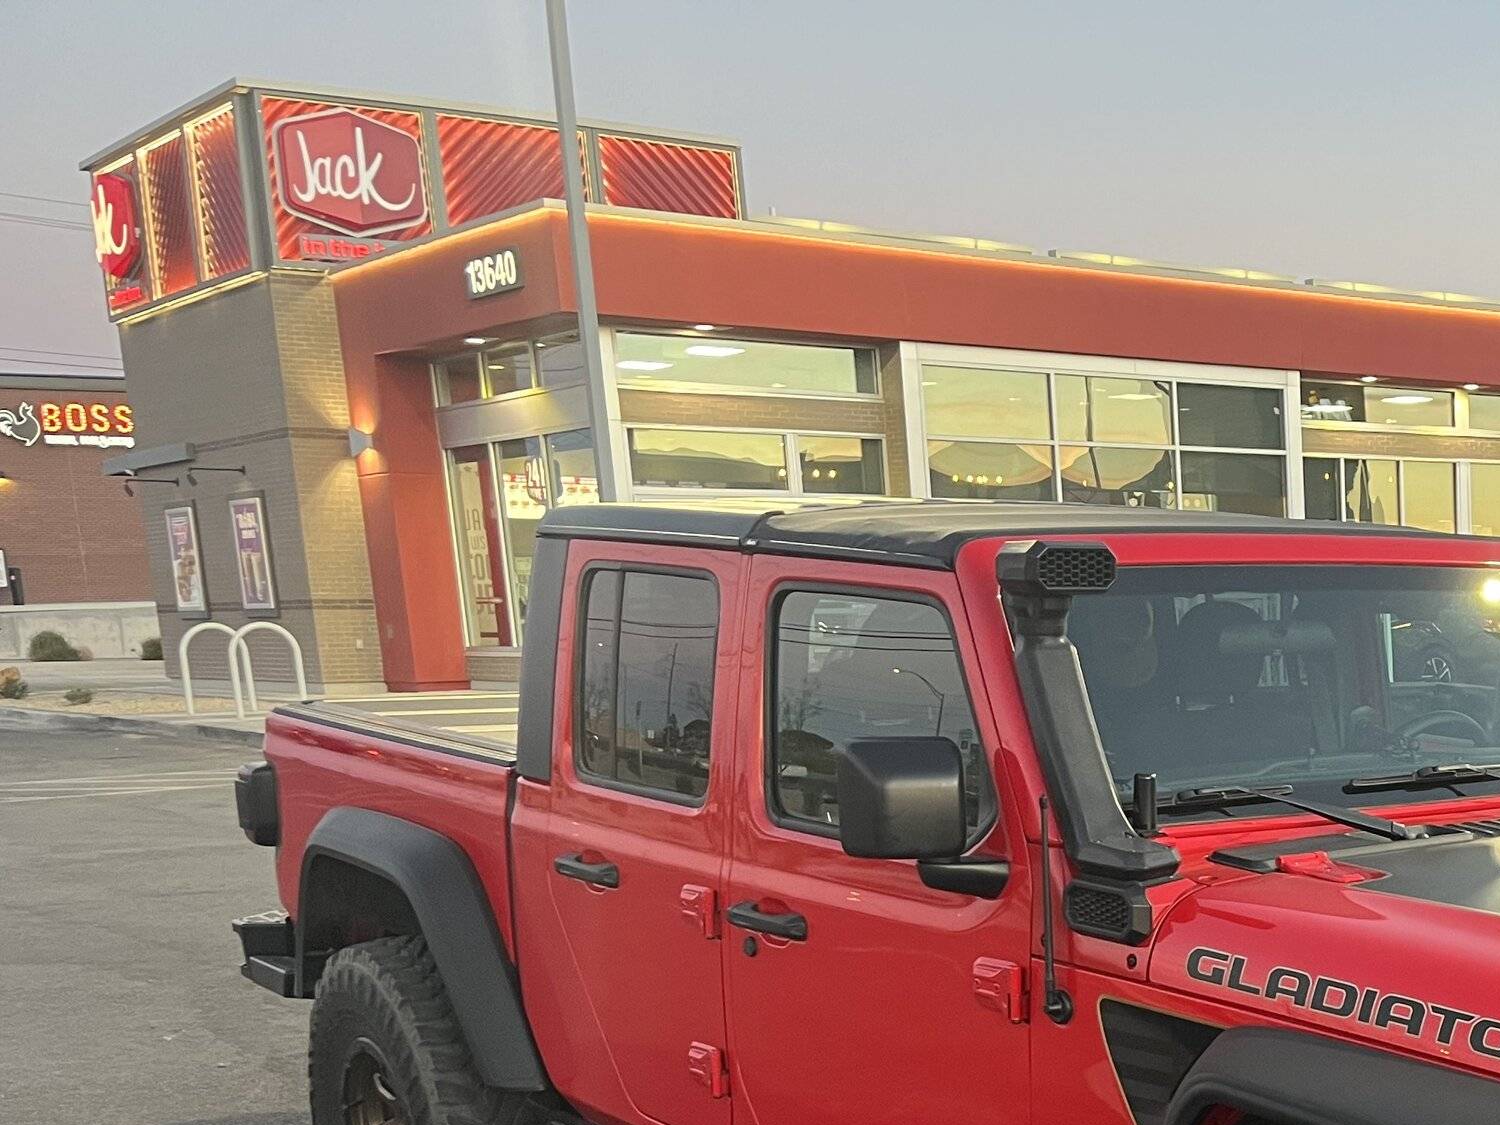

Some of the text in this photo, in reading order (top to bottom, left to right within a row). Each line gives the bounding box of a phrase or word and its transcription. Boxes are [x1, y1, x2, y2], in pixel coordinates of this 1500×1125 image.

[293, 127, 416, 211] Jack
[329, 239, 369, 258] the
[465, 250, 516, 293] 13640
[41, 403, 134, 433] BOSS
